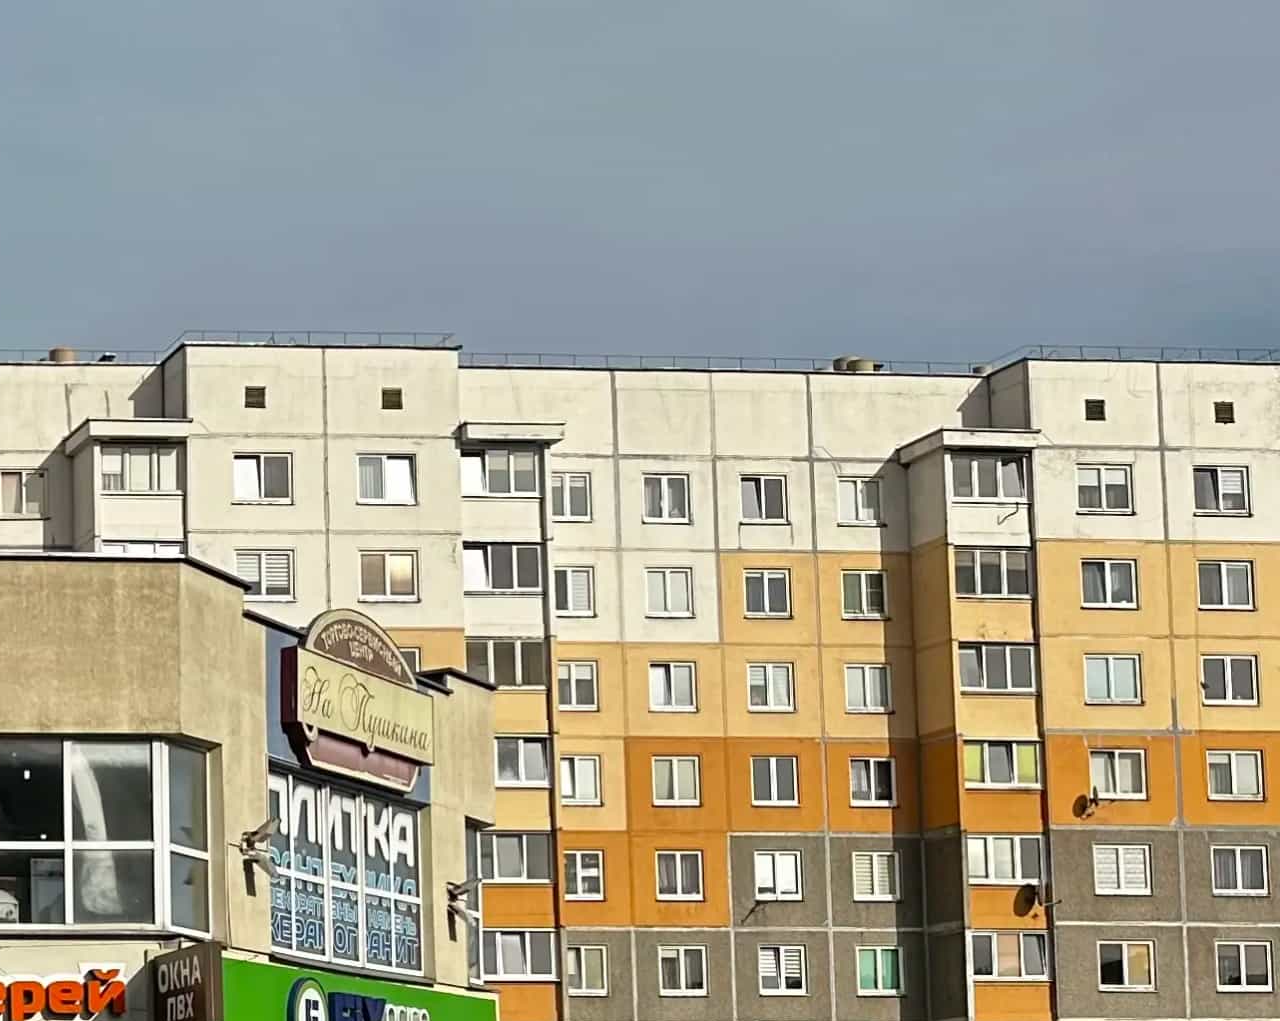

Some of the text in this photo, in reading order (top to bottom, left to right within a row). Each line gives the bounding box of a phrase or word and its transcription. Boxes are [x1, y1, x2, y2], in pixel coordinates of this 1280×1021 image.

[303, 666, 429, 750] На Пушкина
[272, 911, 418, 966] КЕРАОГАНИТ
[158, 955, 202, 994] ОКНА
